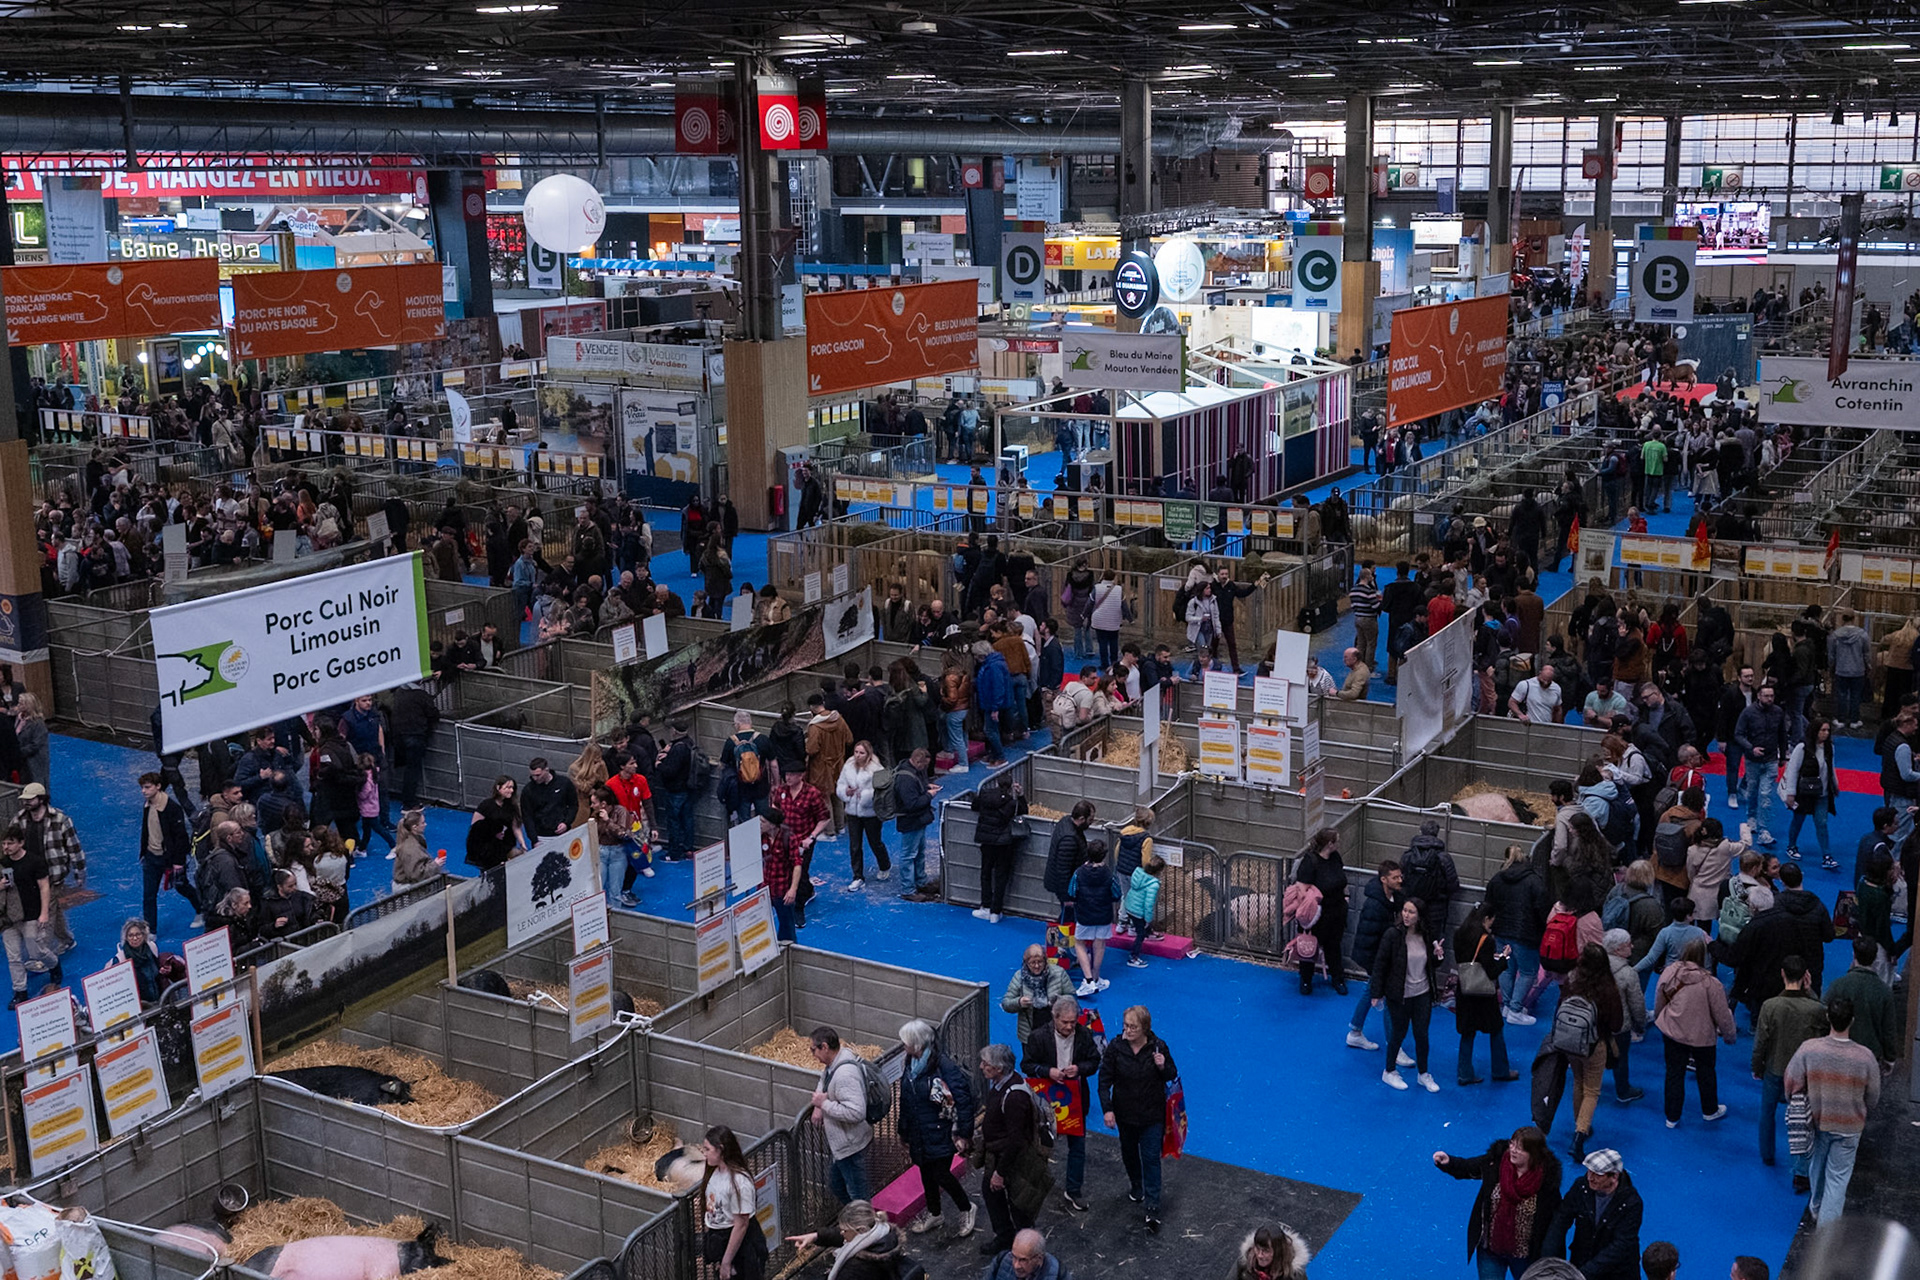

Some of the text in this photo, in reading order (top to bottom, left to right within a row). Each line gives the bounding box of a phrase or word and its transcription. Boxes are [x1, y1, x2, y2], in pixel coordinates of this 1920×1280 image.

[304, 157, 380, 187] MIEUX.
[1002, 233, 1007, 243] 1
[1293, 238, 1299, 248] 1
[120, 237, 179, 259] Game
[191, 237, 262, 259] Arena
[1641, 243, 1647, 253] 1
[538, 246, 551, 267] E
[1014, 252, 1034, 278] D
[1305, 257, 1329, 286] C
[1655, 263, 1679, 295] B
[5, 293, 73, 304] PORC LANDRACE
[406, 295, 442, 306] MOUTON
[6, 304, 47, 314] FRANÇAIS
[239, 305, 307, 320] PORC PIE NOIR
[7, 313, 85, 325] PORC LARGE WHITE
[240, 317, 318, 334] DU PAYS BASQUE
[934, 320, 949, 331] BLEU
[811, 338, 865, 356] PORC GASCON
[925, 334, 951, 347] MOUTON
[585, 343, 619, 355] VENDÉE
[1109, 349, 1173, 361] Bleu du Maine
[1392, 354, 1419, 373] PORC CUL
[1482, 351, 1507, 369] COTENTIN
[1104, 363, 1179, 375] Mouton Vendéen
[1391, 369, 1432, 392] NOIR LIMOUSIN
[1832, 378, 1913, 392] Avranchin
[1835, 396, 1903, 411] Cotentin
[265, 585, 400, 634] Porc Cul Noir
[289, 616, 380, 655] Limousin
[273, 646, 401, 694] Porc Gascon
[517, 921, 527, 933] LE
[527, 912, 547, 928] NOIR
[547, 908, 557, 919] DE
